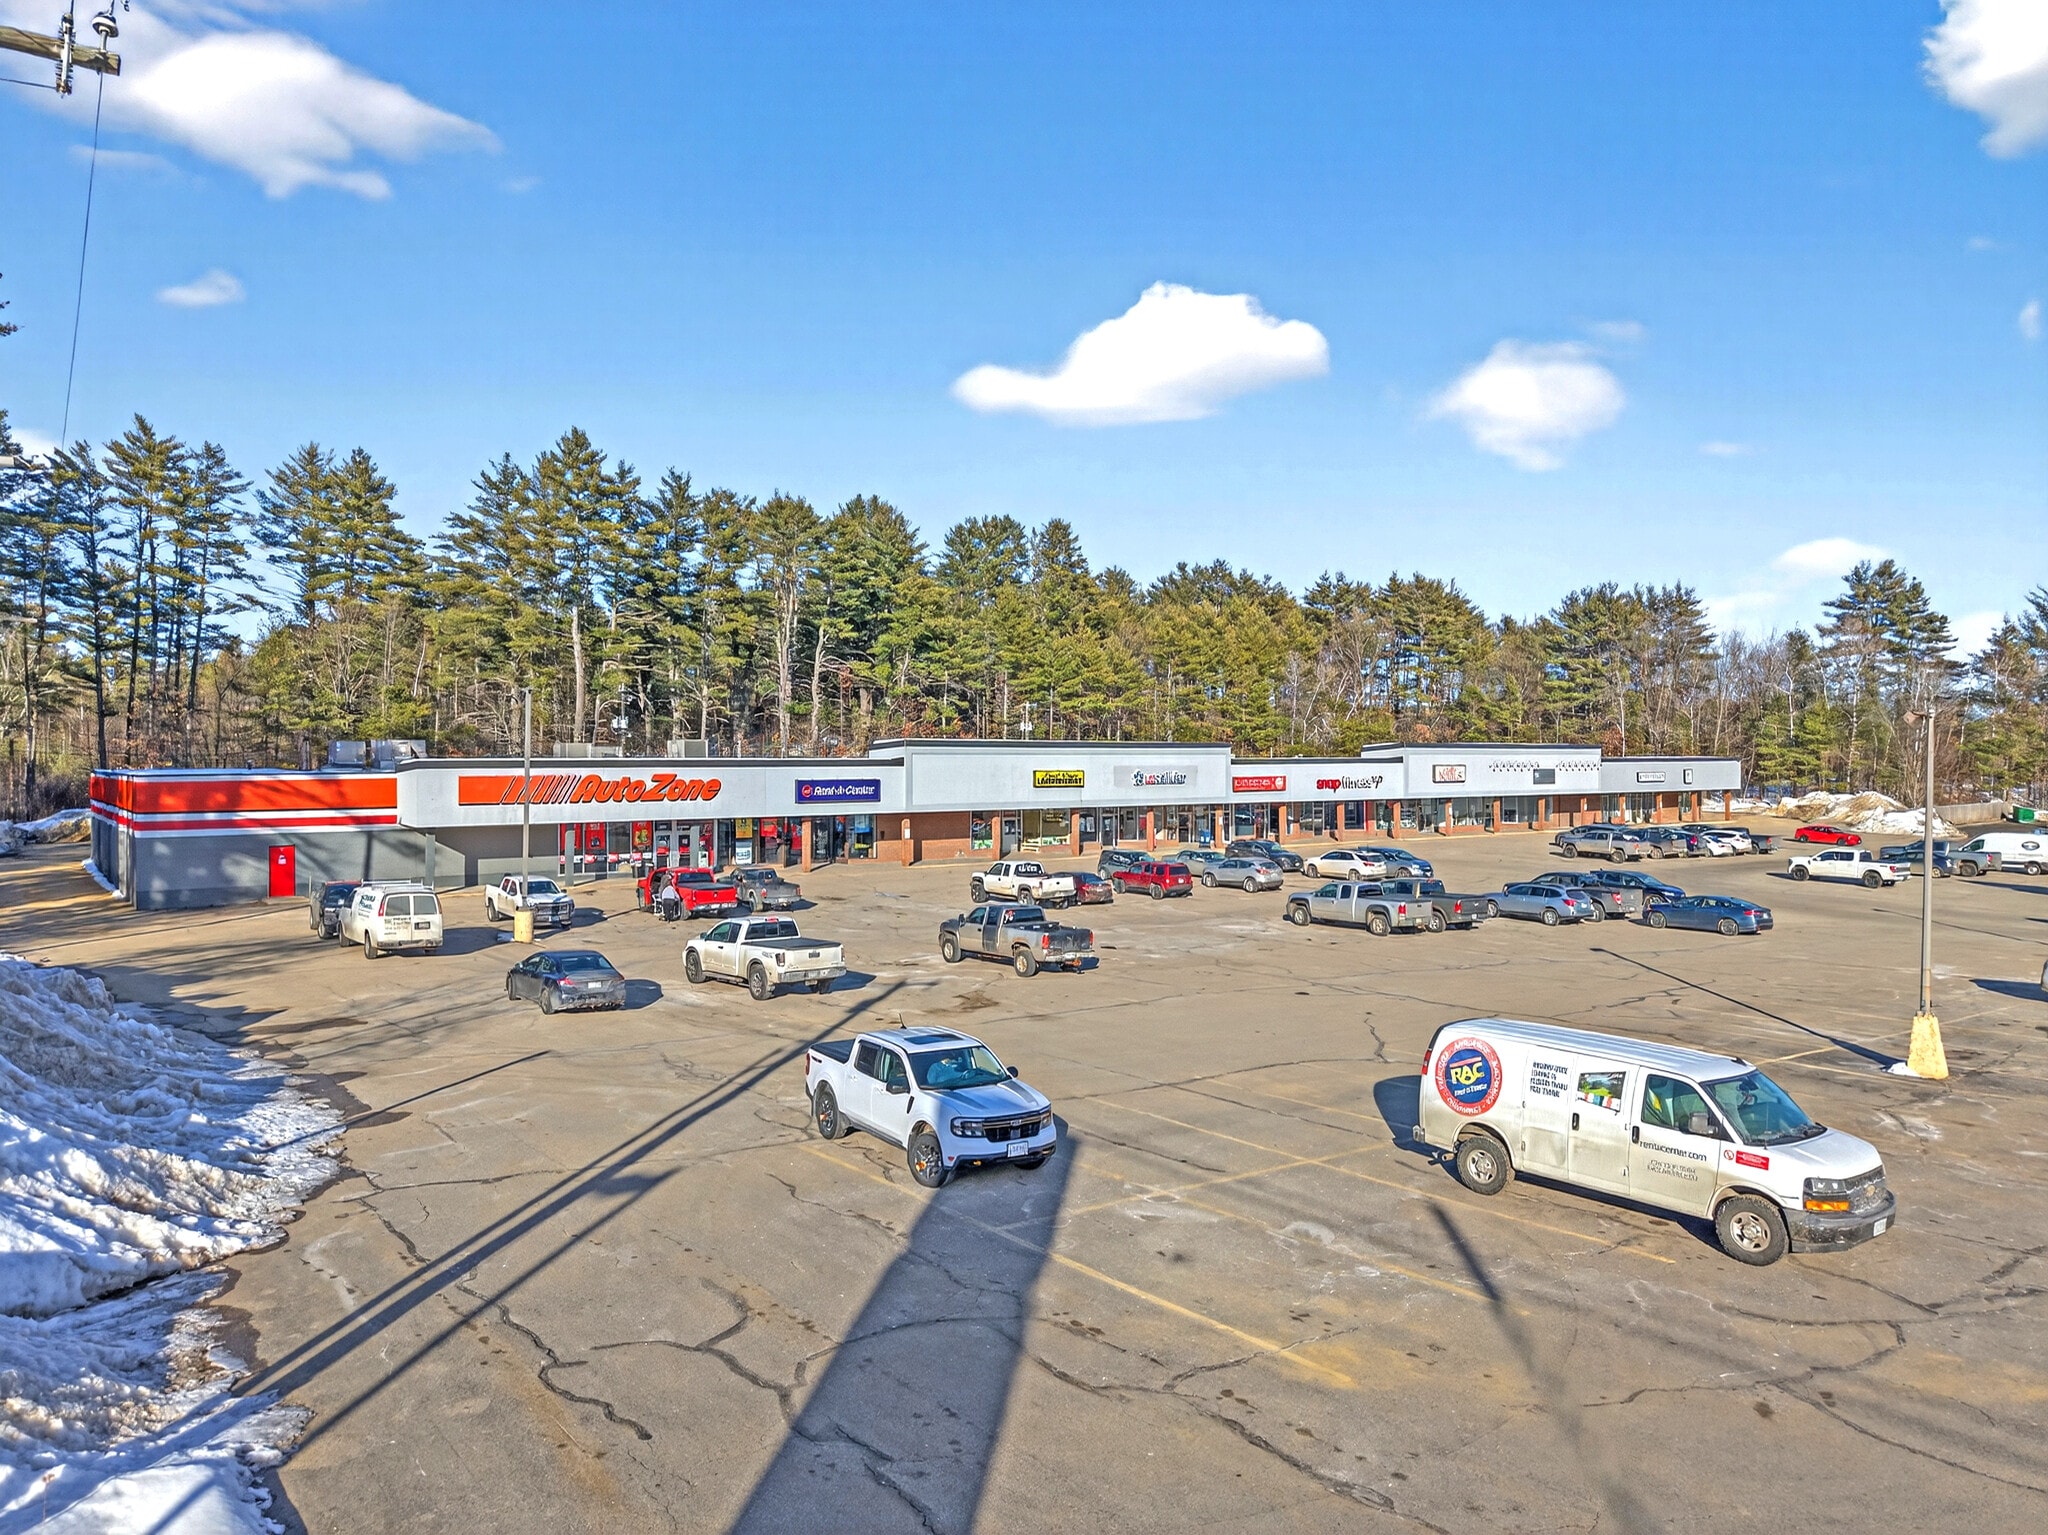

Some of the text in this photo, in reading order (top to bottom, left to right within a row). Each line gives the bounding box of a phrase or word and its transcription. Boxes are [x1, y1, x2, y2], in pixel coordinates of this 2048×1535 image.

[570, 773, 721, 802] AutoZone
[1450, 1061, 1485, 1085] RAC
[1639, 1140, 1707, 1162] rentcencom
